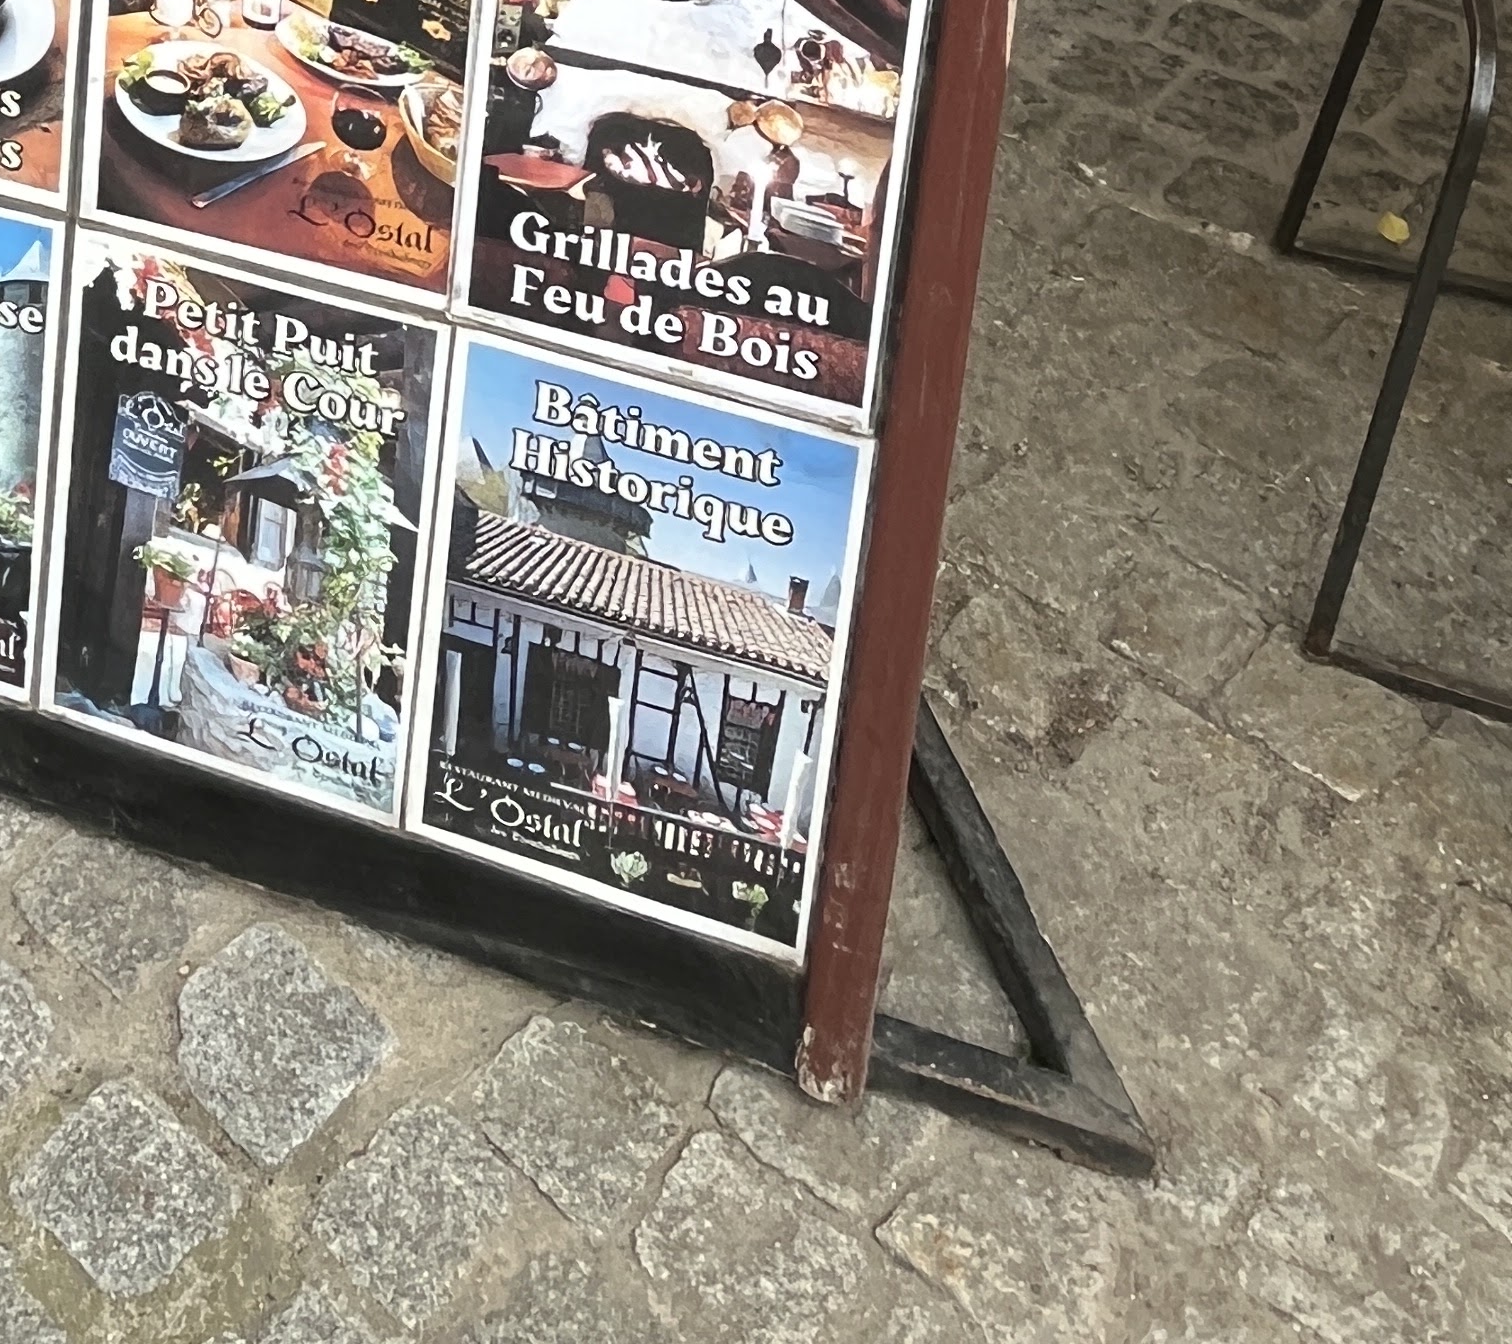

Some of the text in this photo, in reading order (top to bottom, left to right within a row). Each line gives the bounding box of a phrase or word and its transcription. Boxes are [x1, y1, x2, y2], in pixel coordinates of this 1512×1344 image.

[509, 211, 752, 306] Grillades
[763, 282, 830, 326] au
[509, 263, 819, 380] Feu de Bois
[110, 326, 408, 438] dans le Cour
[141, 278, 379, 377] Petit Puit
[510, 427, 795, 547] Historique
[532, 379, 784, 487] Bâtiment
[433, 772, 584, 847] L'Ostal
